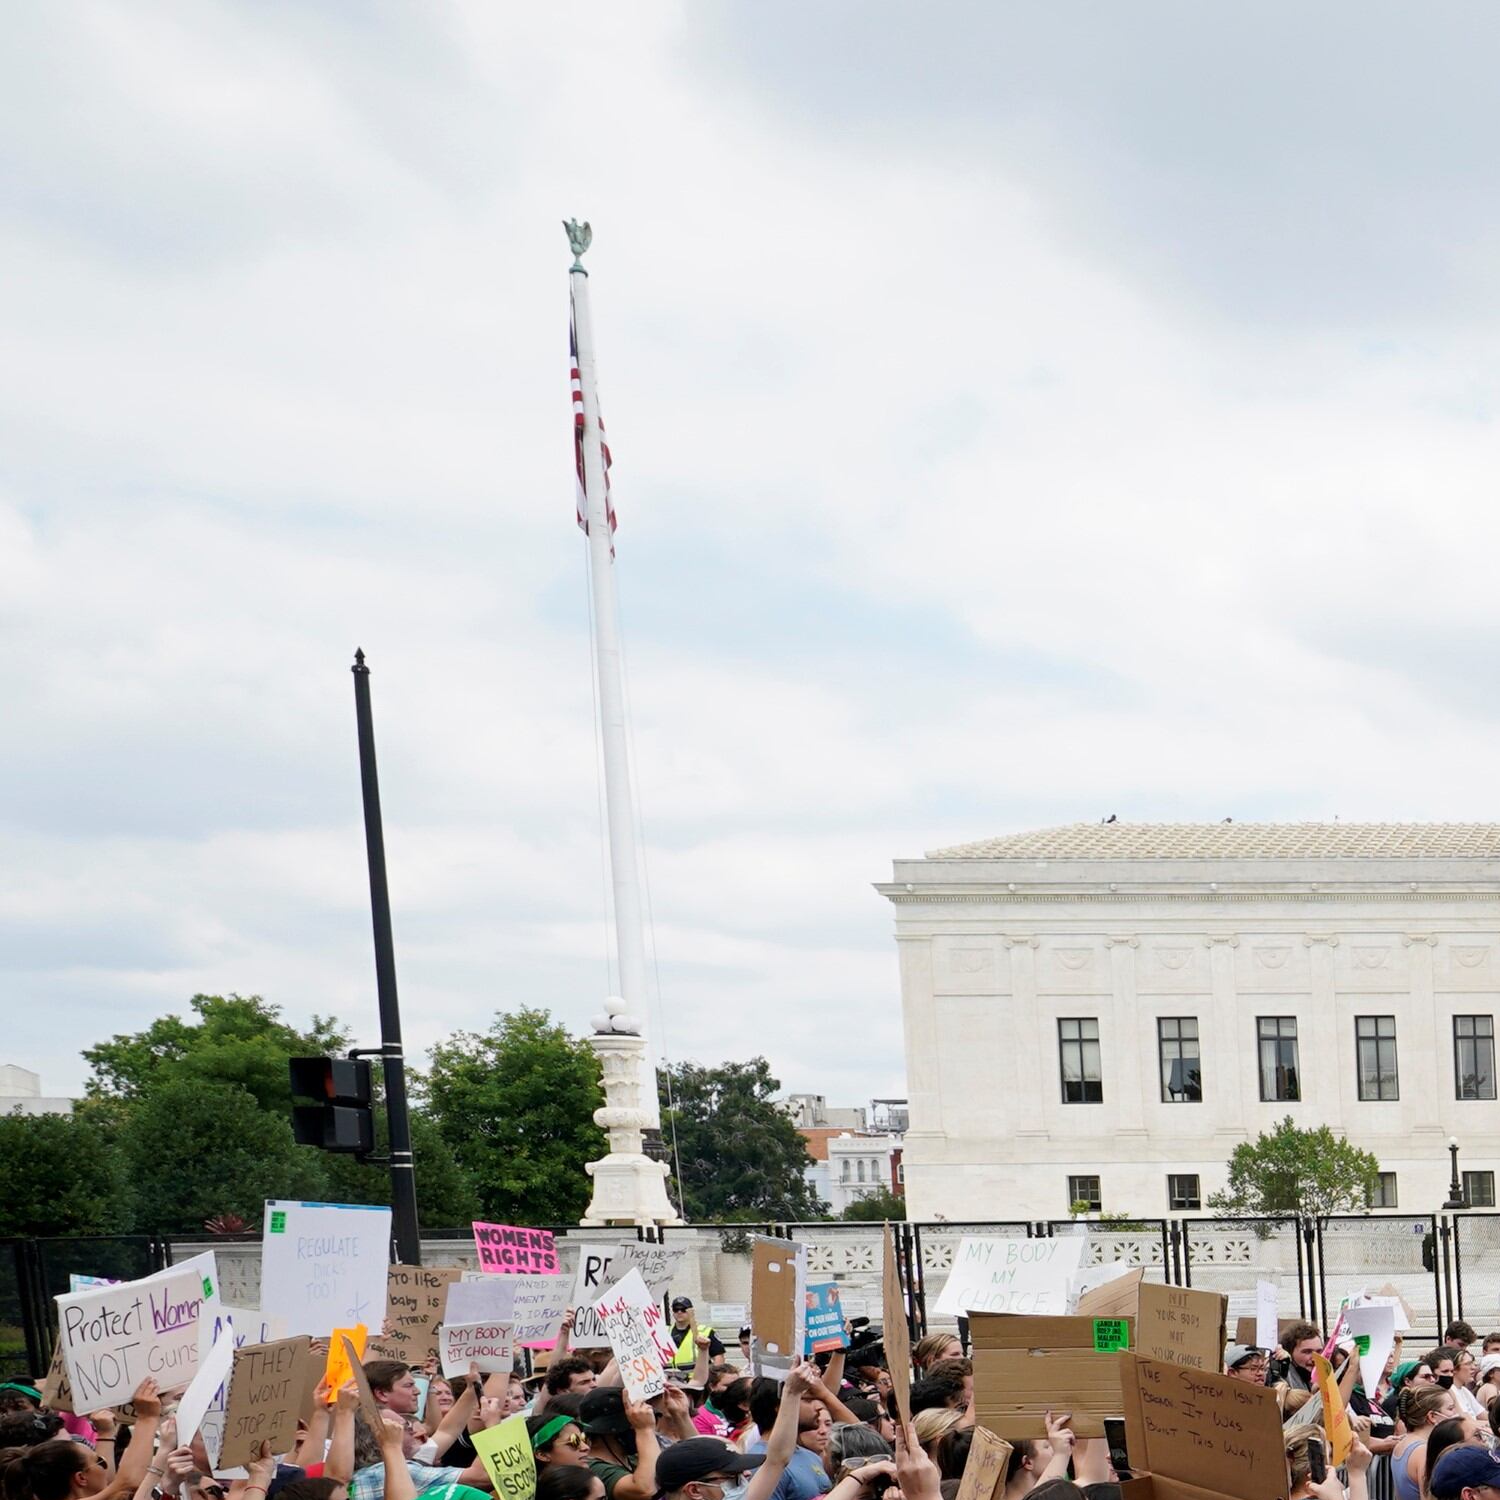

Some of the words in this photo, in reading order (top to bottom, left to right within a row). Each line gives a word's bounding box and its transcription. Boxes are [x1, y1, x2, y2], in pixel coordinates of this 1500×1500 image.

[297, 1236, 360, 1260] REGULATE
[481, 1247, 555, 1269] RIGHTS
[965, 1243, 995, 1265] MY
[1006, 1241, 1061, 1265] BODY
[991, 1267, 1017, 1285] MY
[388, 1294, 418, 1311] baby
[428, 1294, 440, 1308] is
[1168, 1293, 1189, 1306] NOT
[64, 1297, 142, 1347] Protect
[1155, 1309, 1177, 1322] YOUR
[449, 1329, 470, 1343] MY
[475, 1326, 511, 1339] BODY
[1169, 1330, 1186, 1343] NOT
[245, 1345, 298, 1381] THEY
[448, 1349, 463, 1361] MY
[465, 1346, 511, 1358] CHOICE
[1177, 1353, 1203, 1369] CHOICE
[75, 1342, 140, 1400] NOT
[1138, 1360, 1161, 1383] THE
[249, 1379, 291, 1405] WONT
[234, 1412, 266, 1438] STOP
[270, 1410, 288, 1431] AT
[1181, 1401, 1203, 1418] IT
[1213, 1411, 1243, 1432] WAS
[490, 1443, 524, 1472] FUCK
